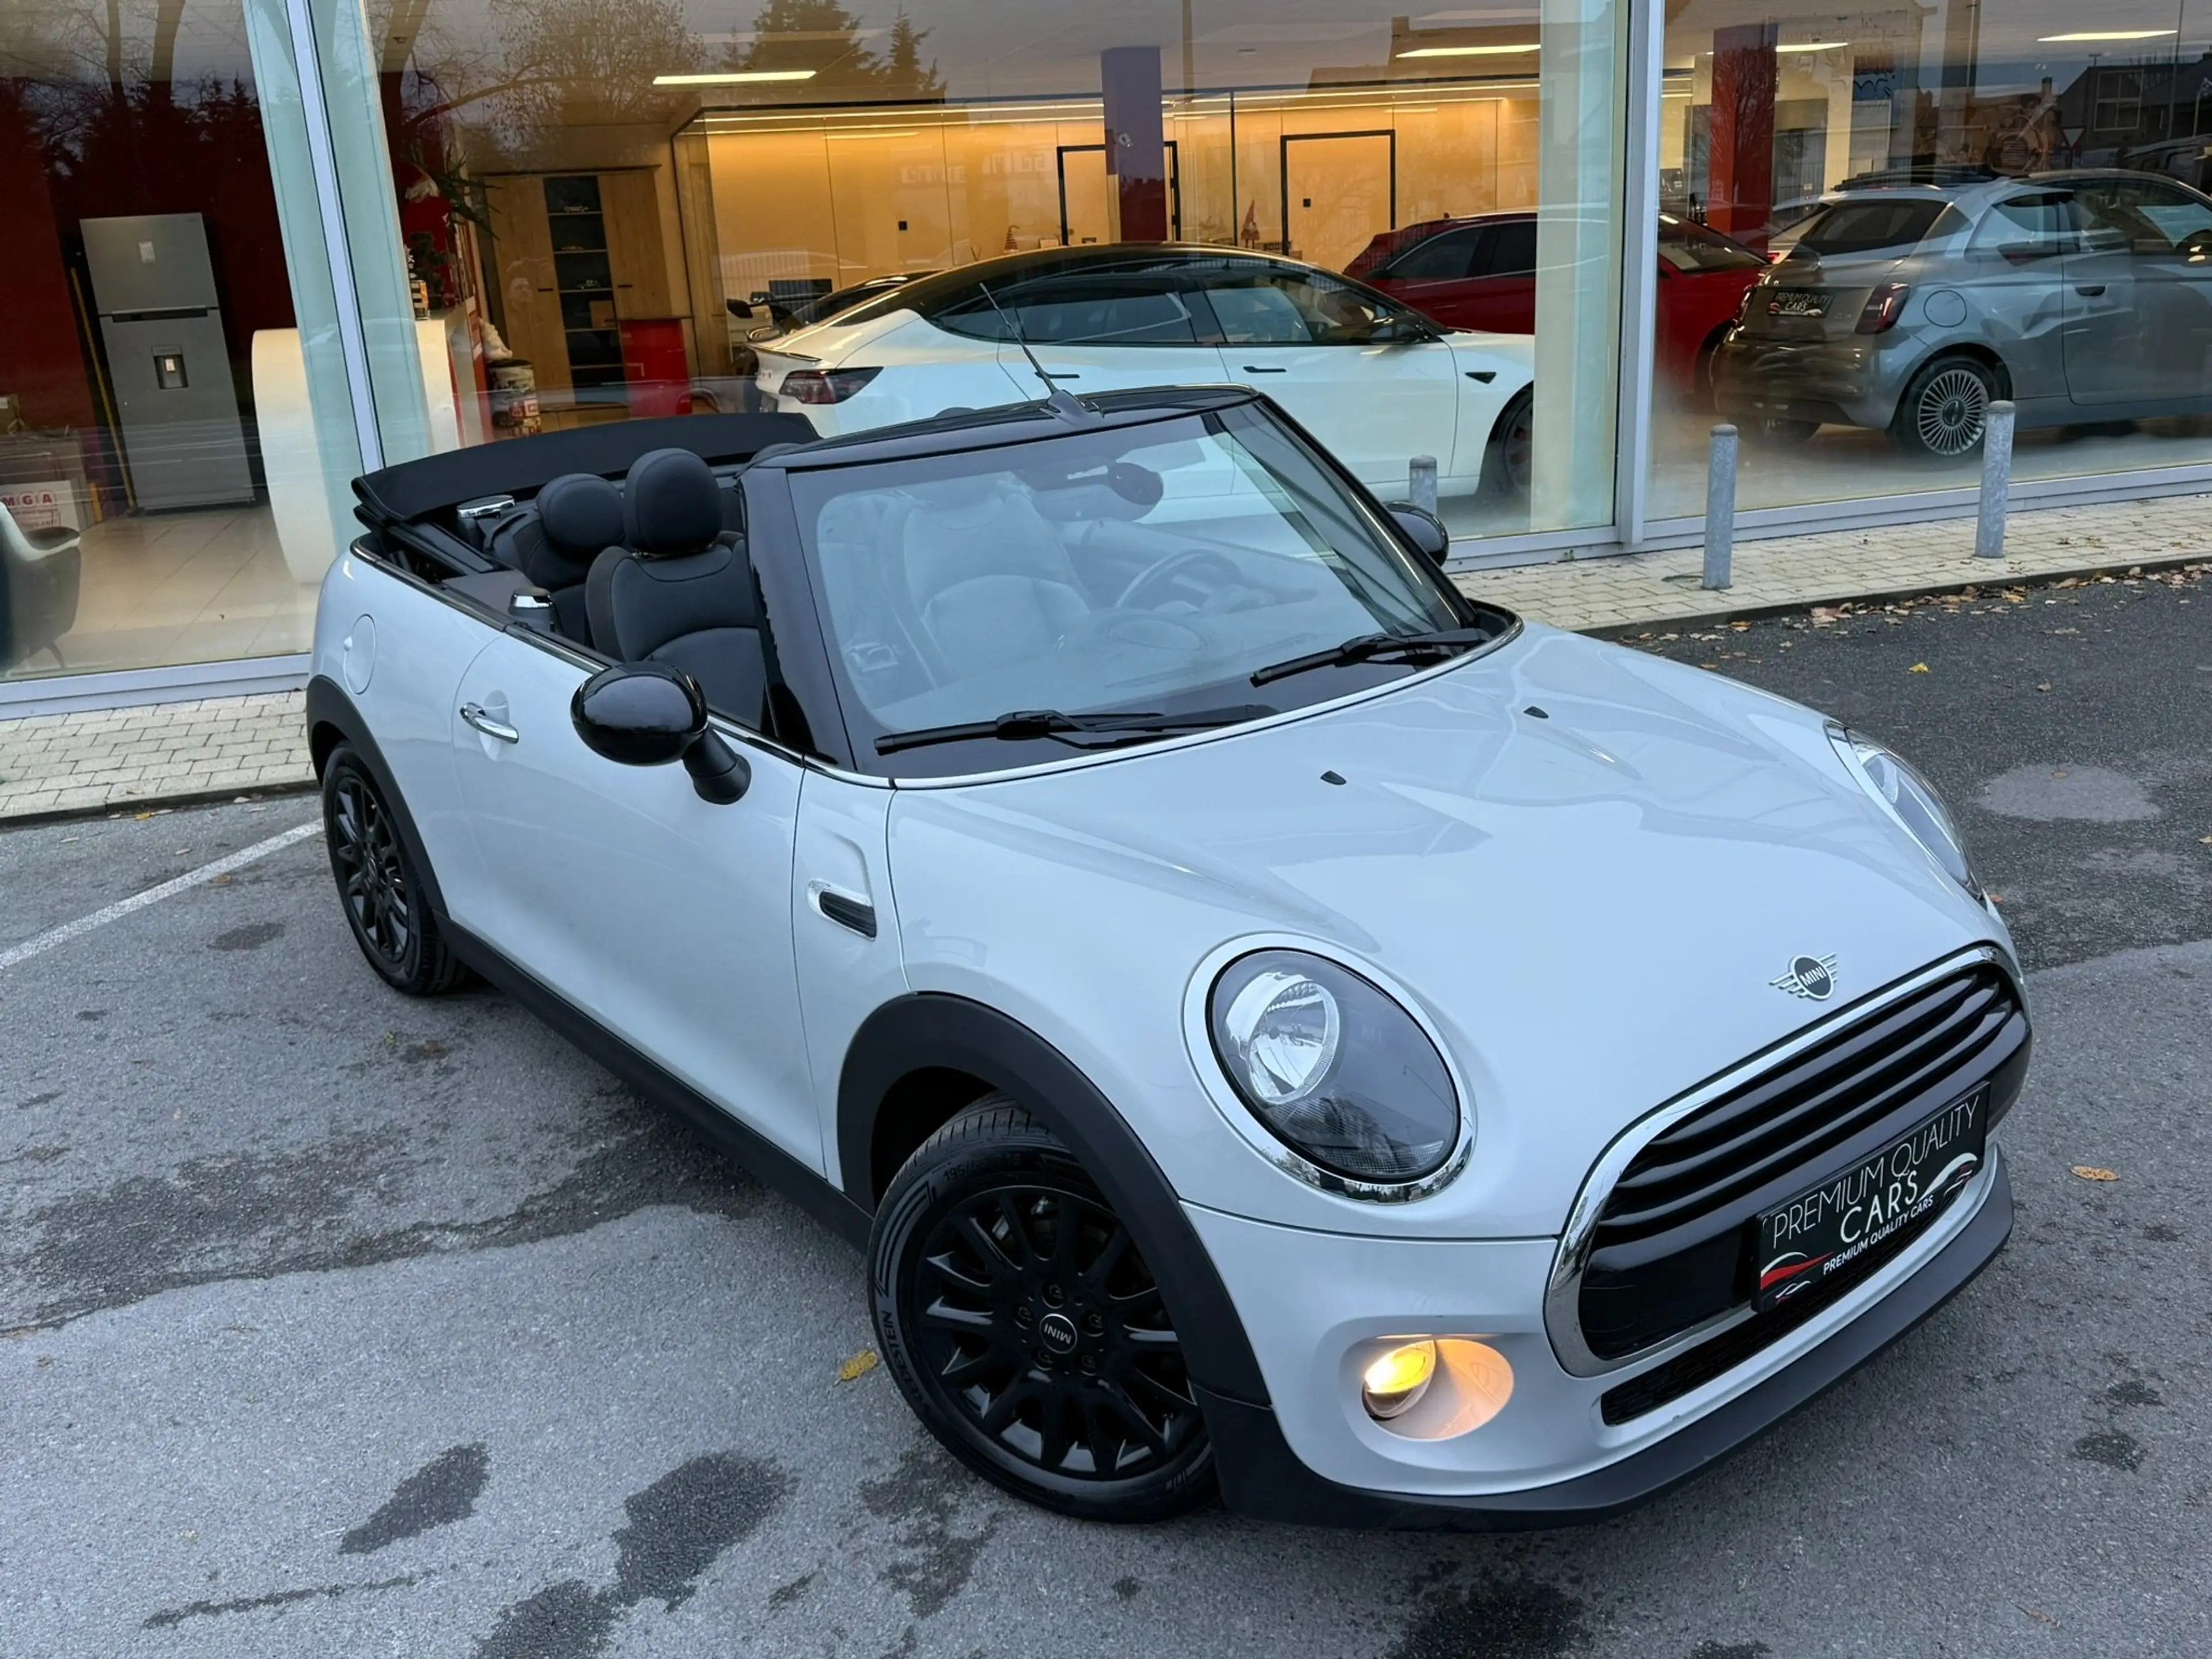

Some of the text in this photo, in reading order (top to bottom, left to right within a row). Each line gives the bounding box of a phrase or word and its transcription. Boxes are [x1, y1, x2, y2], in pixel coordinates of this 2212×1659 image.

[1785, 301, 1808, 312] CARS
[1799, 966, 1827, 986] MINI
[1773, 1095, 1979, 1249] PREMIUM QUALITY
[1839, 1170, 1918, 1243] CARS
[1823, 1195, 1934, 1275] PREMIUM QUALITY CARS
[1044, 1323, 1071, 1344] MINI
